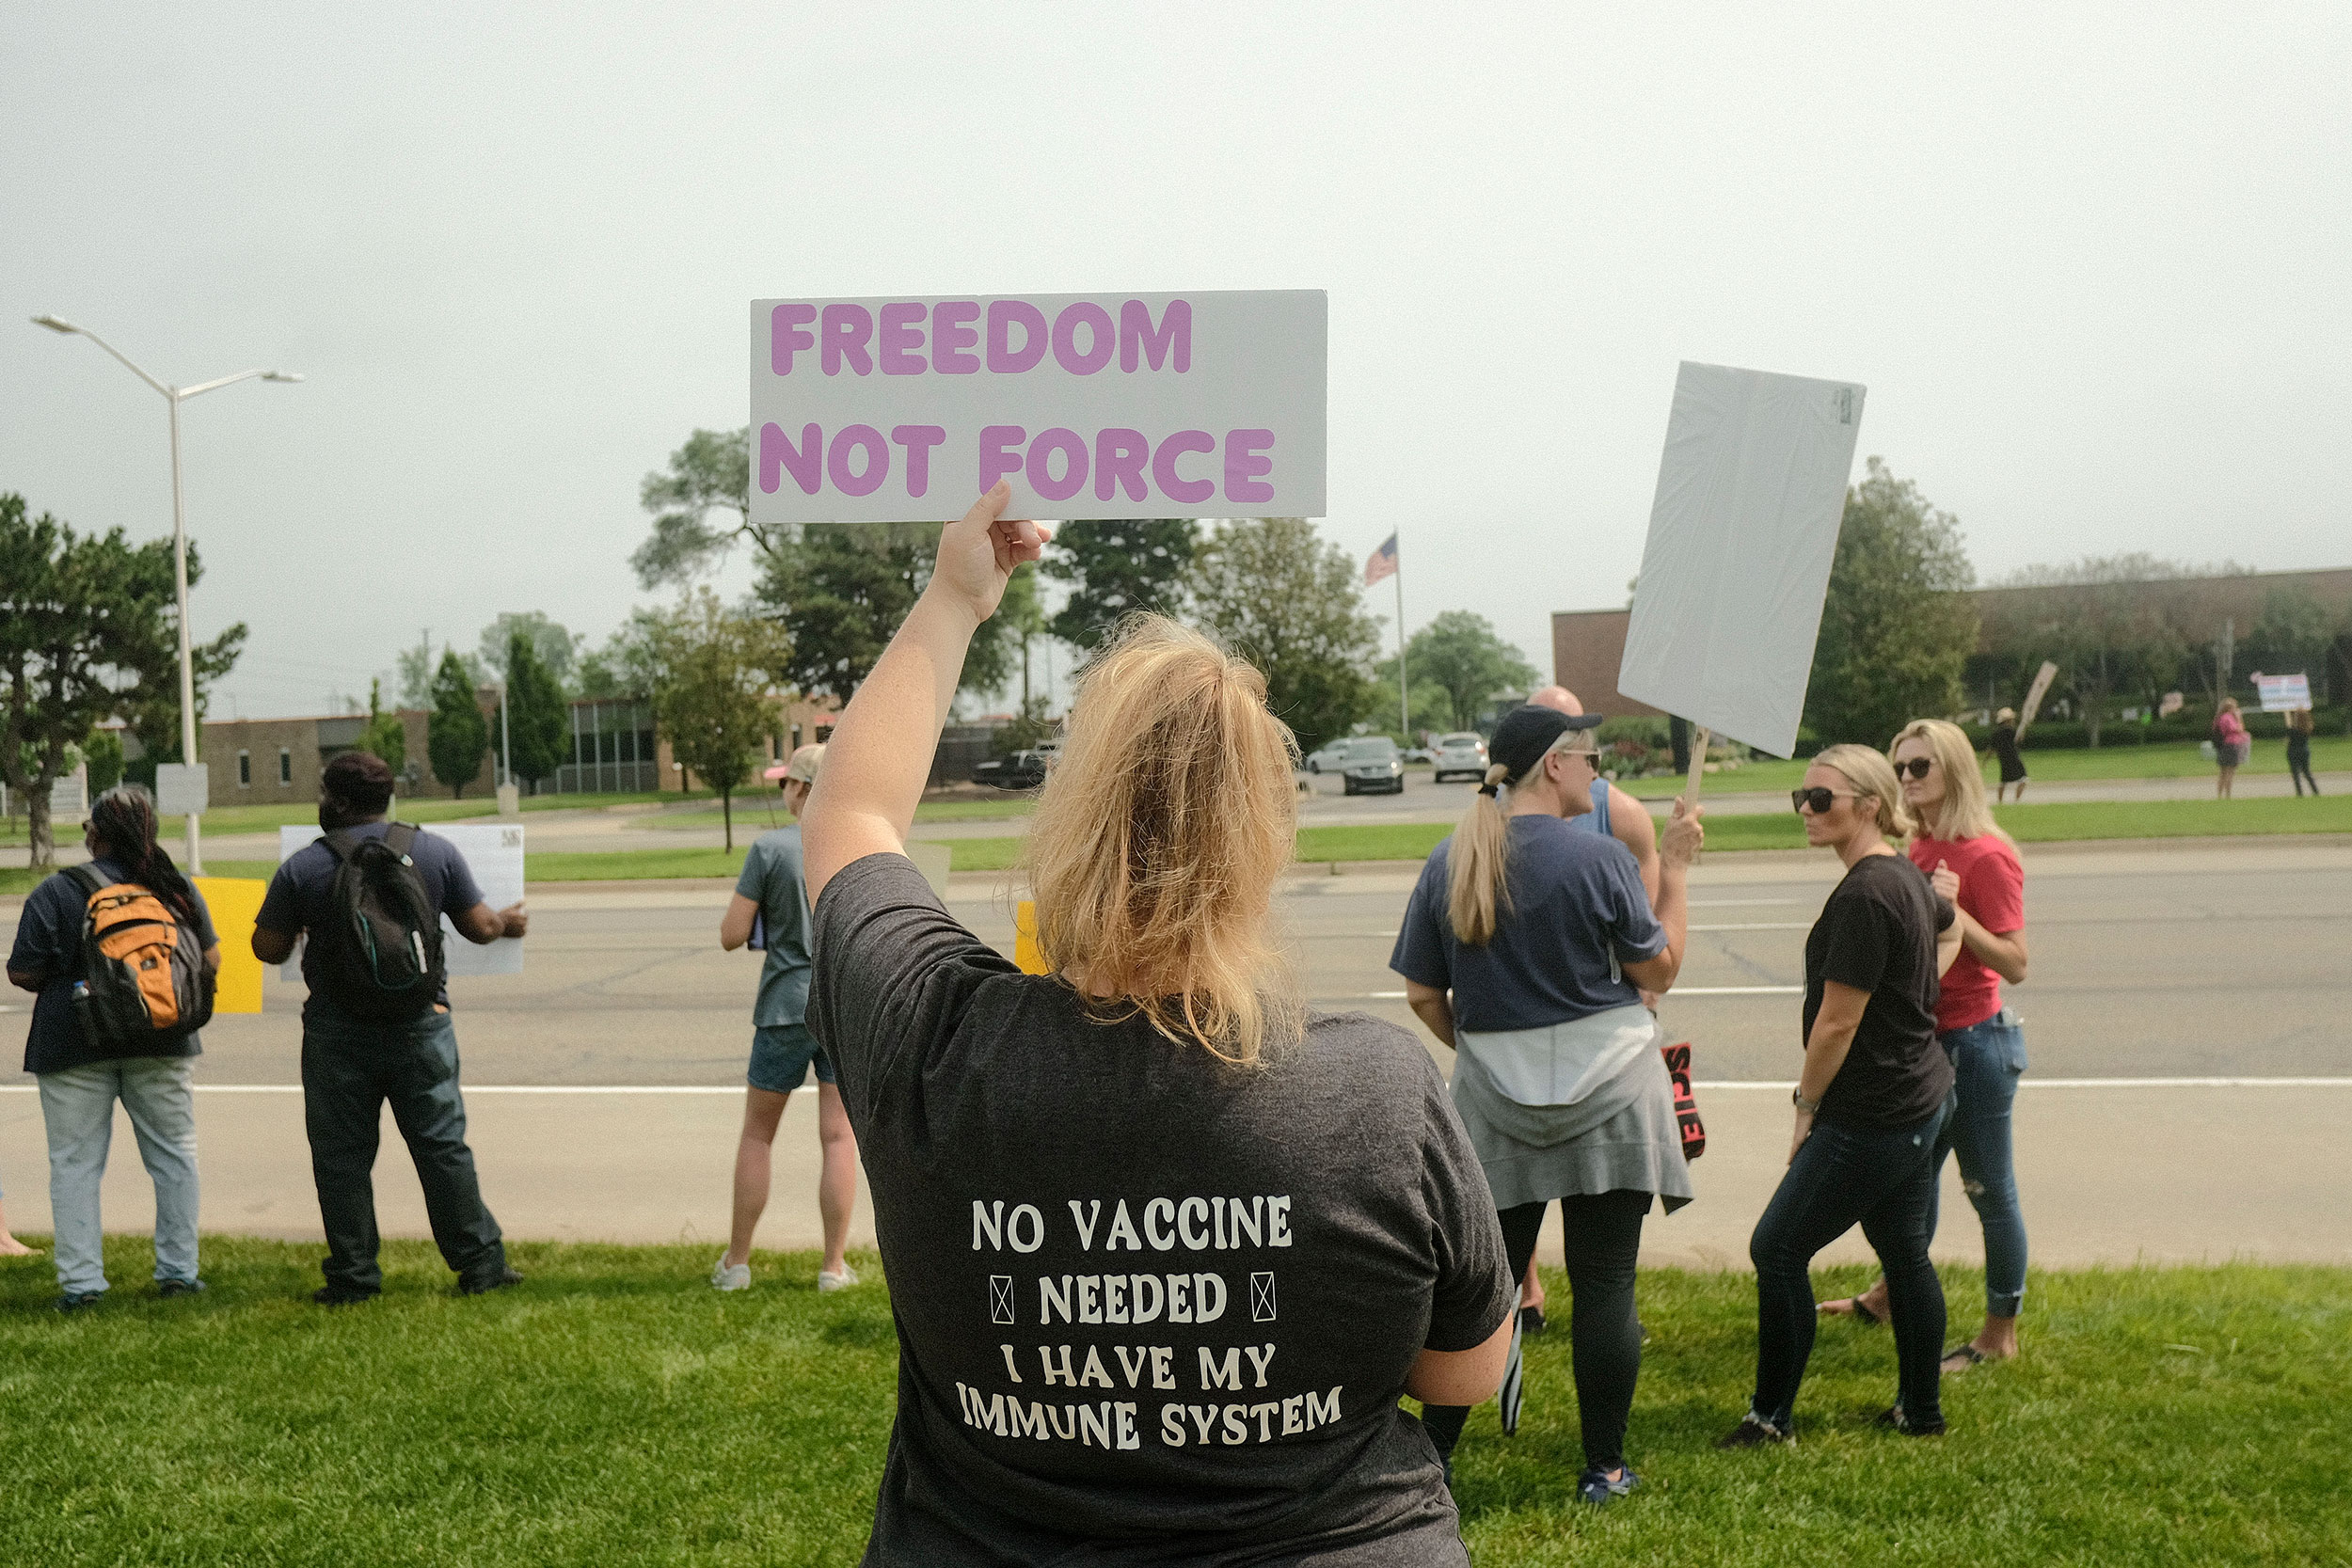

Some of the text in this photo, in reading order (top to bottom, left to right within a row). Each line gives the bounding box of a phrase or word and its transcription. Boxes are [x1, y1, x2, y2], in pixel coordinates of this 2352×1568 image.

[771, 299, 1192, 376] FREEDOM
[758, 422, 1275, 504] NOT FORCE
[972, 1195, 1293, 1254] NO VACCINE
[1038, 1272, 1228, 1325] NEEDED
[1000, 1342, 1277, 1391] I HAVE MY
[955, 1381, 1343, 1450] IMMUNE SYSTEM
